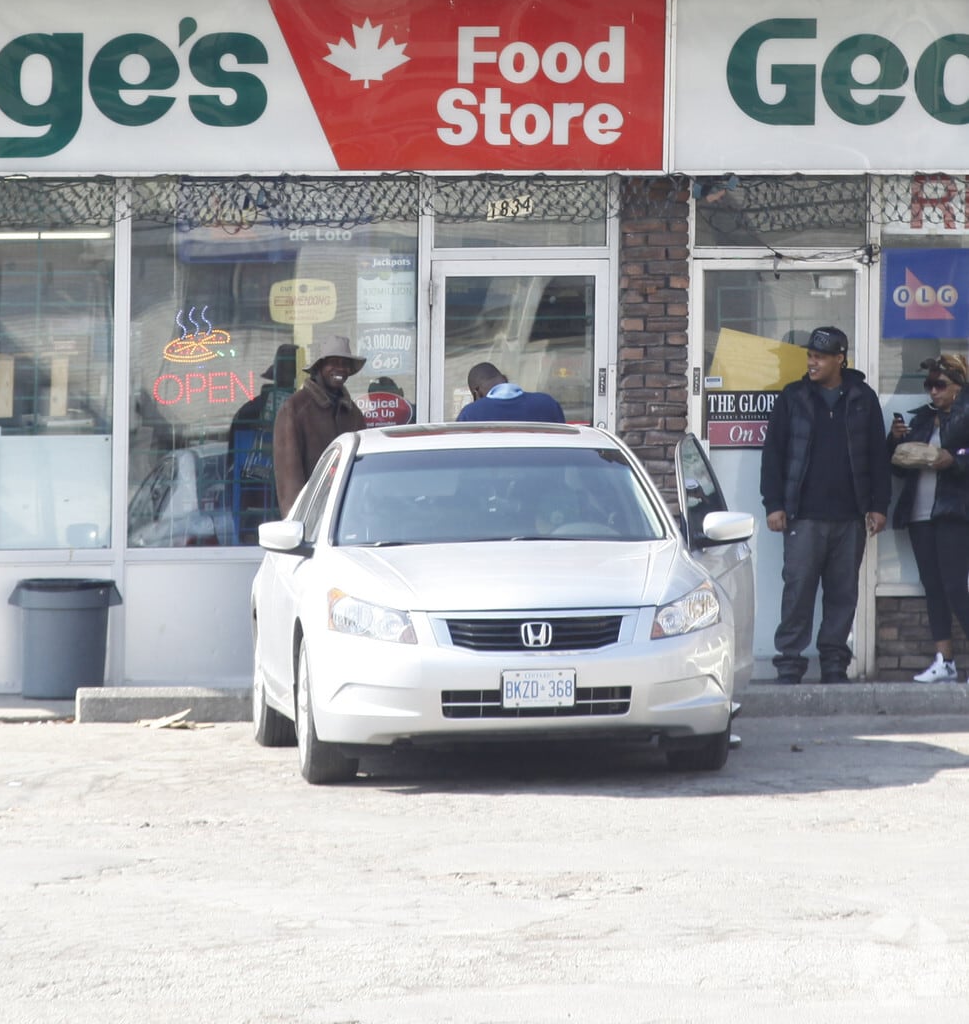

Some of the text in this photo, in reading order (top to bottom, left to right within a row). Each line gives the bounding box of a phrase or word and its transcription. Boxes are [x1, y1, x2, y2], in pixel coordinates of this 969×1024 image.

[457, 26, 626, 85] Food
[436, 87, 624, 146] Store
[490, 196, 531, 218] 1834
[910, 175, 969, 229] R
[289, 228, 352, 242] de Loto
[372, 258, 412, 268] Jackpots
[897, 287, 953, 305] OLG
[153, 370, 256, 406] OPEN
[357, 397, 399, 411] Digicel
[381, 408, 395, 418] Up
[708, 394, 779, 413] THE GLOB
[730, 425, 753, 442] On
[505, 679, 573, 699] BKZD 368
